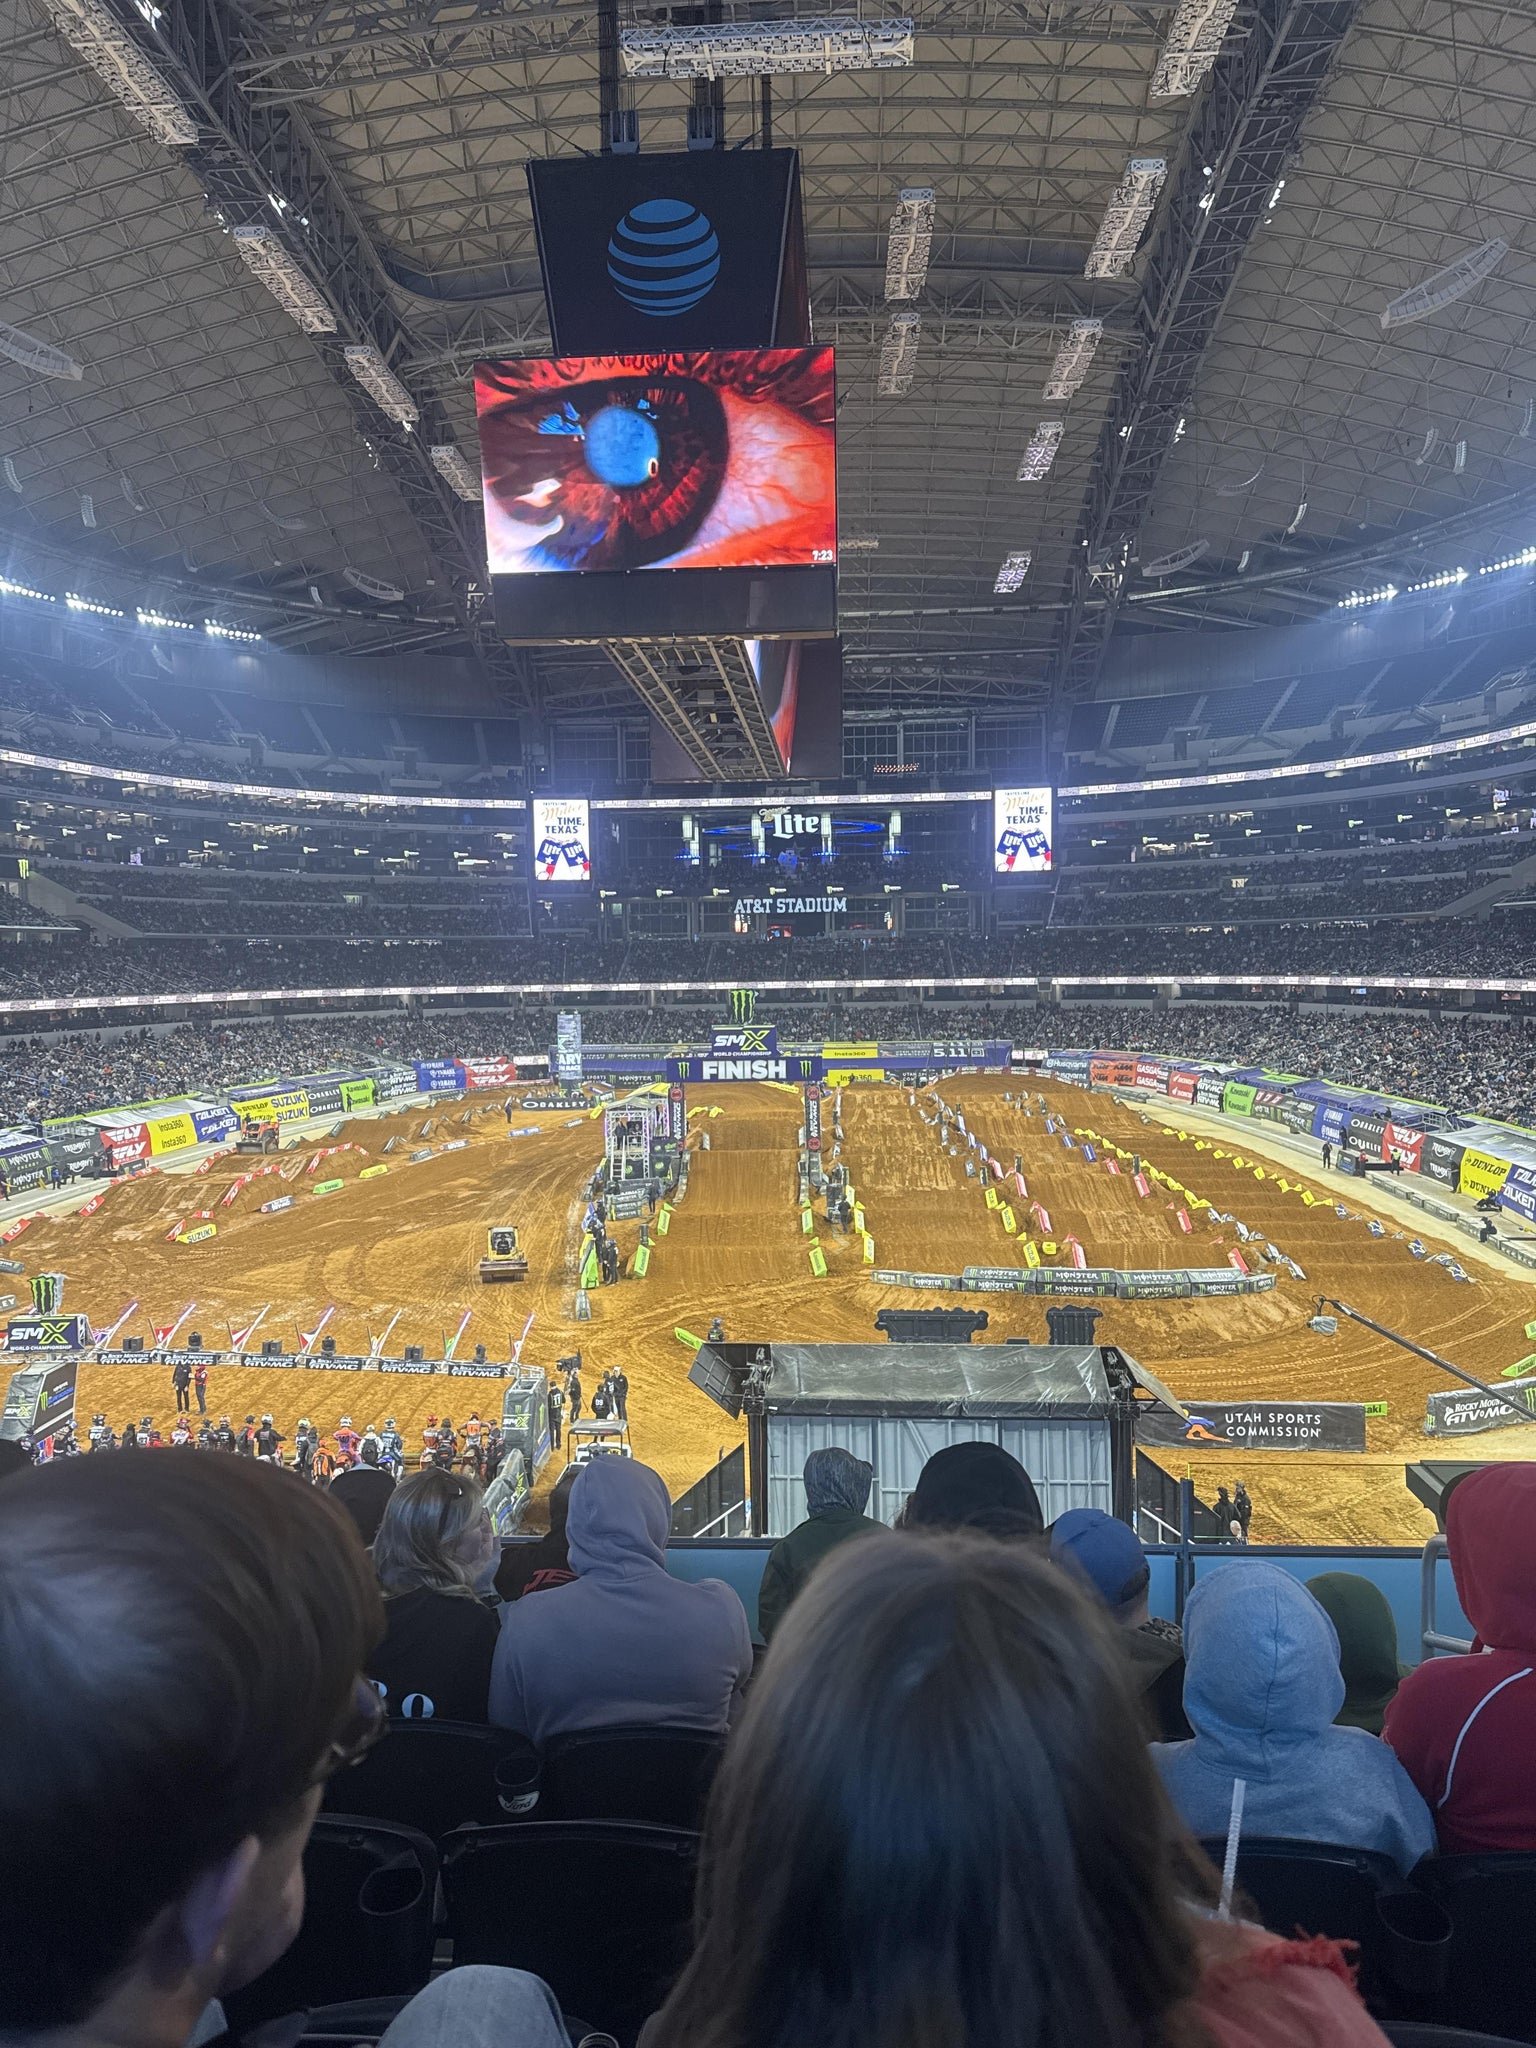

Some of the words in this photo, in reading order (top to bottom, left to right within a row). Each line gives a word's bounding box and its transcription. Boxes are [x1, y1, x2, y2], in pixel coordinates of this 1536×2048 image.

[812, 549, 833, 561] 7:23
[1019, 806, 1048, 815] TIME,
[557, 817, 585, 826] TIME,
[1006, 815, 1041, 824] TEXAS
[545, 825, 578, 834] TEXAS
[773, 813, 819, 839] Lite
[734, 899, 773, 914] AT&T
[776, 897, 848, 913] STADIUM
[714, 1030, 770, 1051] SMX
[934, 1048, 968, 1057] 5.11
[468, 1064, 509, 1073] FLY
[702, 1060, 787, 1080] FINISH
[1054, 1059, 1088, 1069] Husqvarna
[471, 1075, 510, 1084] FLY
[346, 1083, 369, 1092] Kawasaki
[1230, 1087, 1251, 1097] Kawasaki
[271, 1093, 307, 1108] SUZUKI
[318, 1101, 342, 1111] OAKLEY
[540, 1100, 587, 1109] OAKLEY
[1228, 1101, 1248, 1111] Kawasaki
[242, 1102, 269, 1112] DUNLOP
[195, 1106, 230, 1121] FALKEN
[276, 1107, 309, 1122] SUZUKI
[158, 1119, 184, 1133] Insta360
[201, 1117, 237, 1136] FALKEN
[105, 1125, 142, 1142] FLY
[1391, 1125, 1423, 1146] FLY
[62, 1139, 91, 1154] TRIUMPH
[161, 1134, 187, 1149] Insta360
[112, 1141, 147, 1160] FLY
[8, 1150, 42, 1166] MONSTER
[1471, 1158, 1507, 1177] DUNLOP
[13, 1170, 45, 1186] MONSTER
[1503, 1184, 1535, 1211] ALKEN
[86, 1199, 98, 1213] FLY
[7, 1223, 22, 1237] FLY
[187, 1227, 213, 1242] SUZUKI
[979, 1269, 1019, 1277] MONSTER
[1055, 1271, 1097, 1280] MONSTER
[1133, 1273, 1174, 1282] MONSTER
[915, 1278, 942, 1286] MONSTER
[978, 1281, 1014, 1290] MONSTER
[1207, 1284, 1237, 1292] MONSTER
[1055, 1284, 1094, 1294] MONSTER
[1137, 1286, 1174, 1296] MONSTER
[10, 1322, 70, 1344] SMX
[1455, 1400, 1479, 1413] ROCKY
[1225, 1413, 1262, 1423] UTAH
[1268, 1413, 1321, 1424] SPORTS
[1226, 1426, 1319, 1438] COMMISSION
